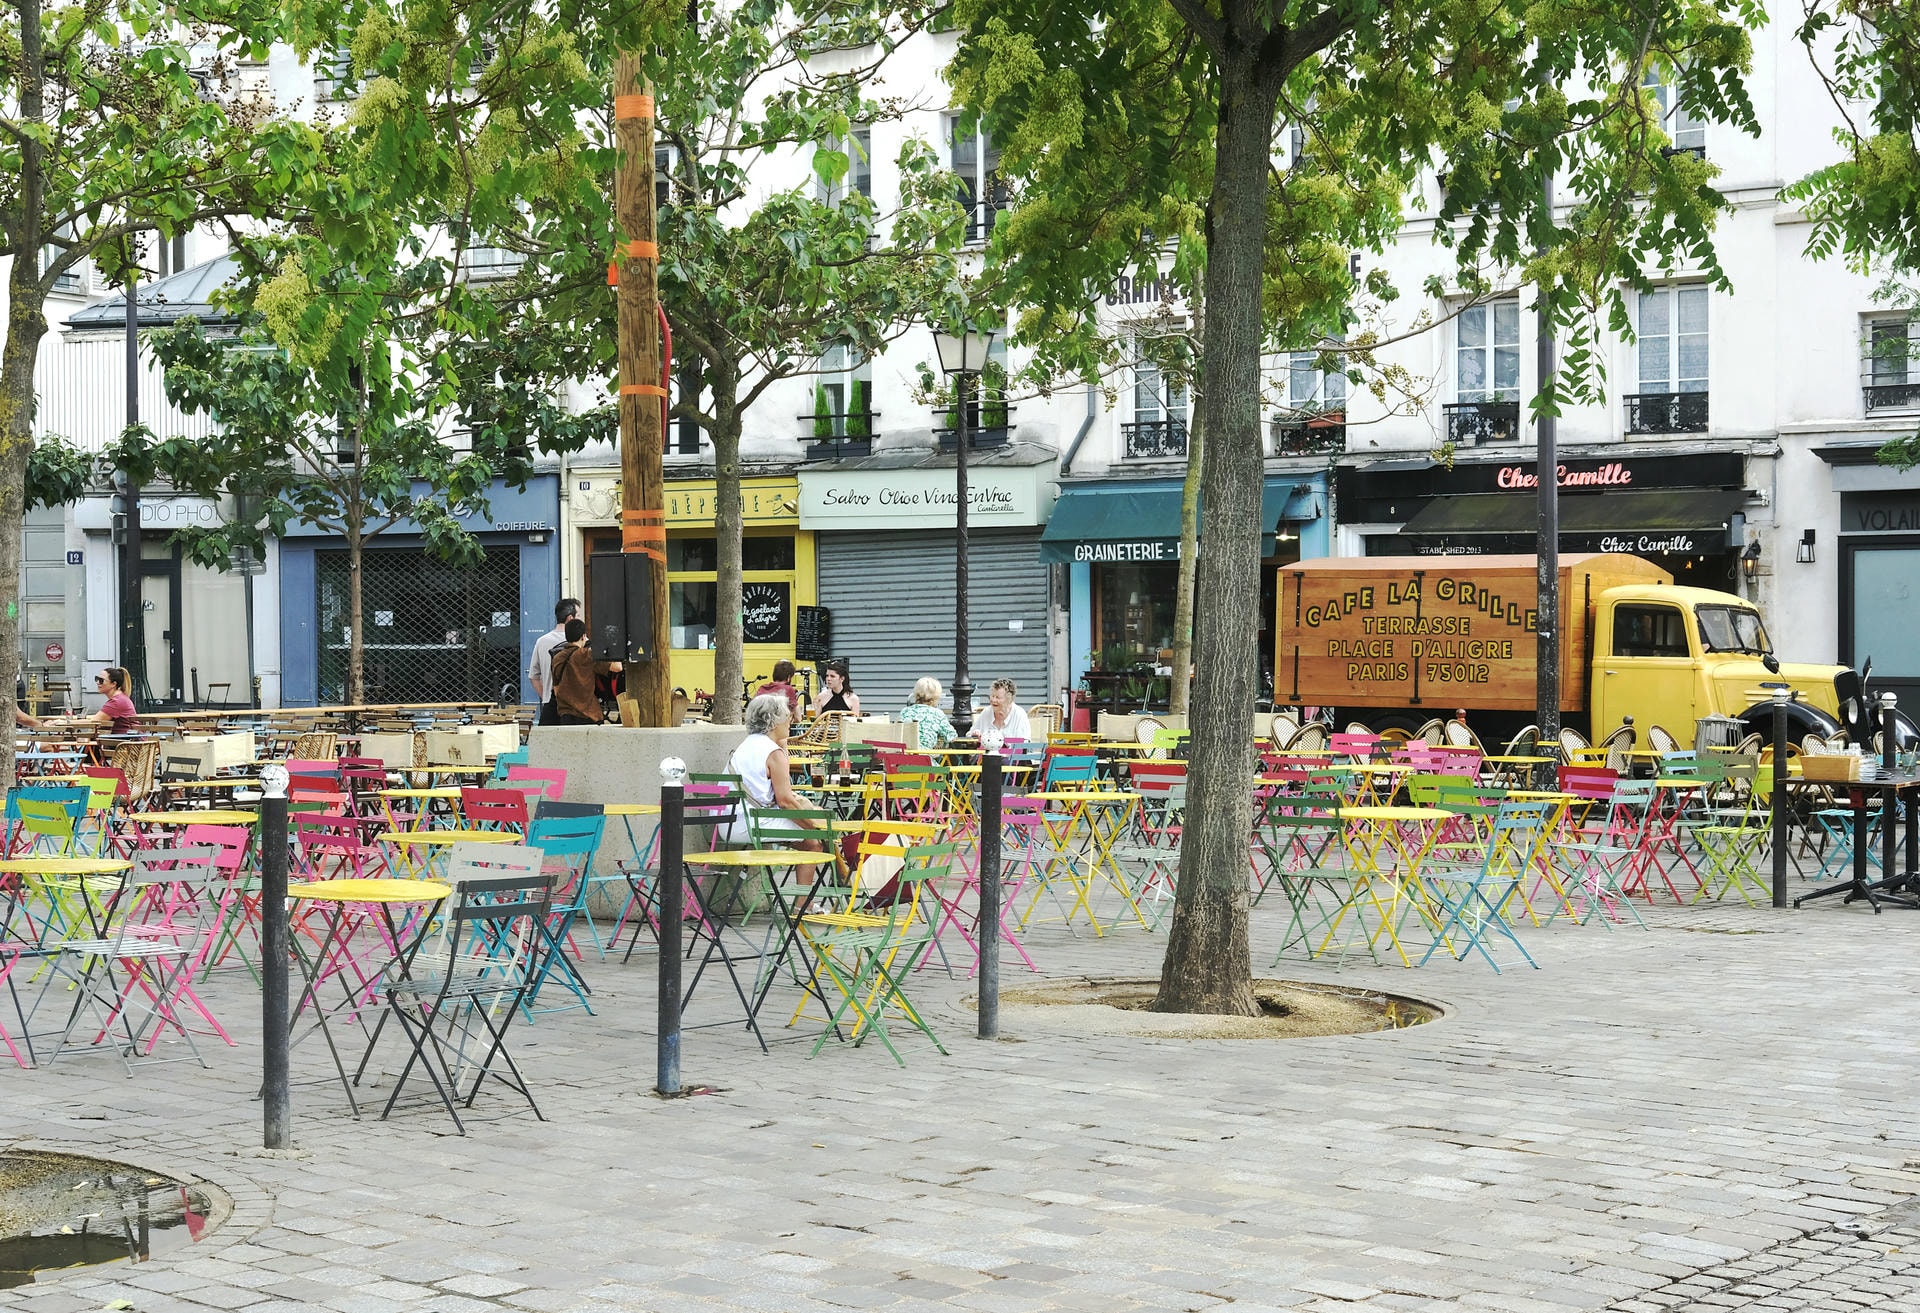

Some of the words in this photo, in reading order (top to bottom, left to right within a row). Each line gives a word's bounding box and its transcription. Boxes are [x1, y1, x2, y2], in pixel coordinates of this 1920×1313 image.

[1556, 462, 1632, 486] Camille
[822, 488, 871, 506] Salvo
[1390, 506, 1395, 514] 8
[495, 520, 546, 532] COIFFURE
[1074, 542, 1164, 561] GRAINETERIE
[1466, 546, 1482, 554] 2013
[1600, 536, 1634, 552] Chez
[1637, 535, 1693, 551] Camille
[69, 552, 80, 563] 12
[1306, 586, 1374, 627] CAFE
[1387, 579, 1421, 605] LA
[1436, 578, 1538, 632] GRILLE
[1363, 616, 1471, 636] TERRASSE
[1327, 640, 1394, 658] PLACE
[1411, 638, 1513, 659] D'ALIGRE
[1347, 662, 1408, 681] PARIS
[1426, 663, 1490, 683] 75012
